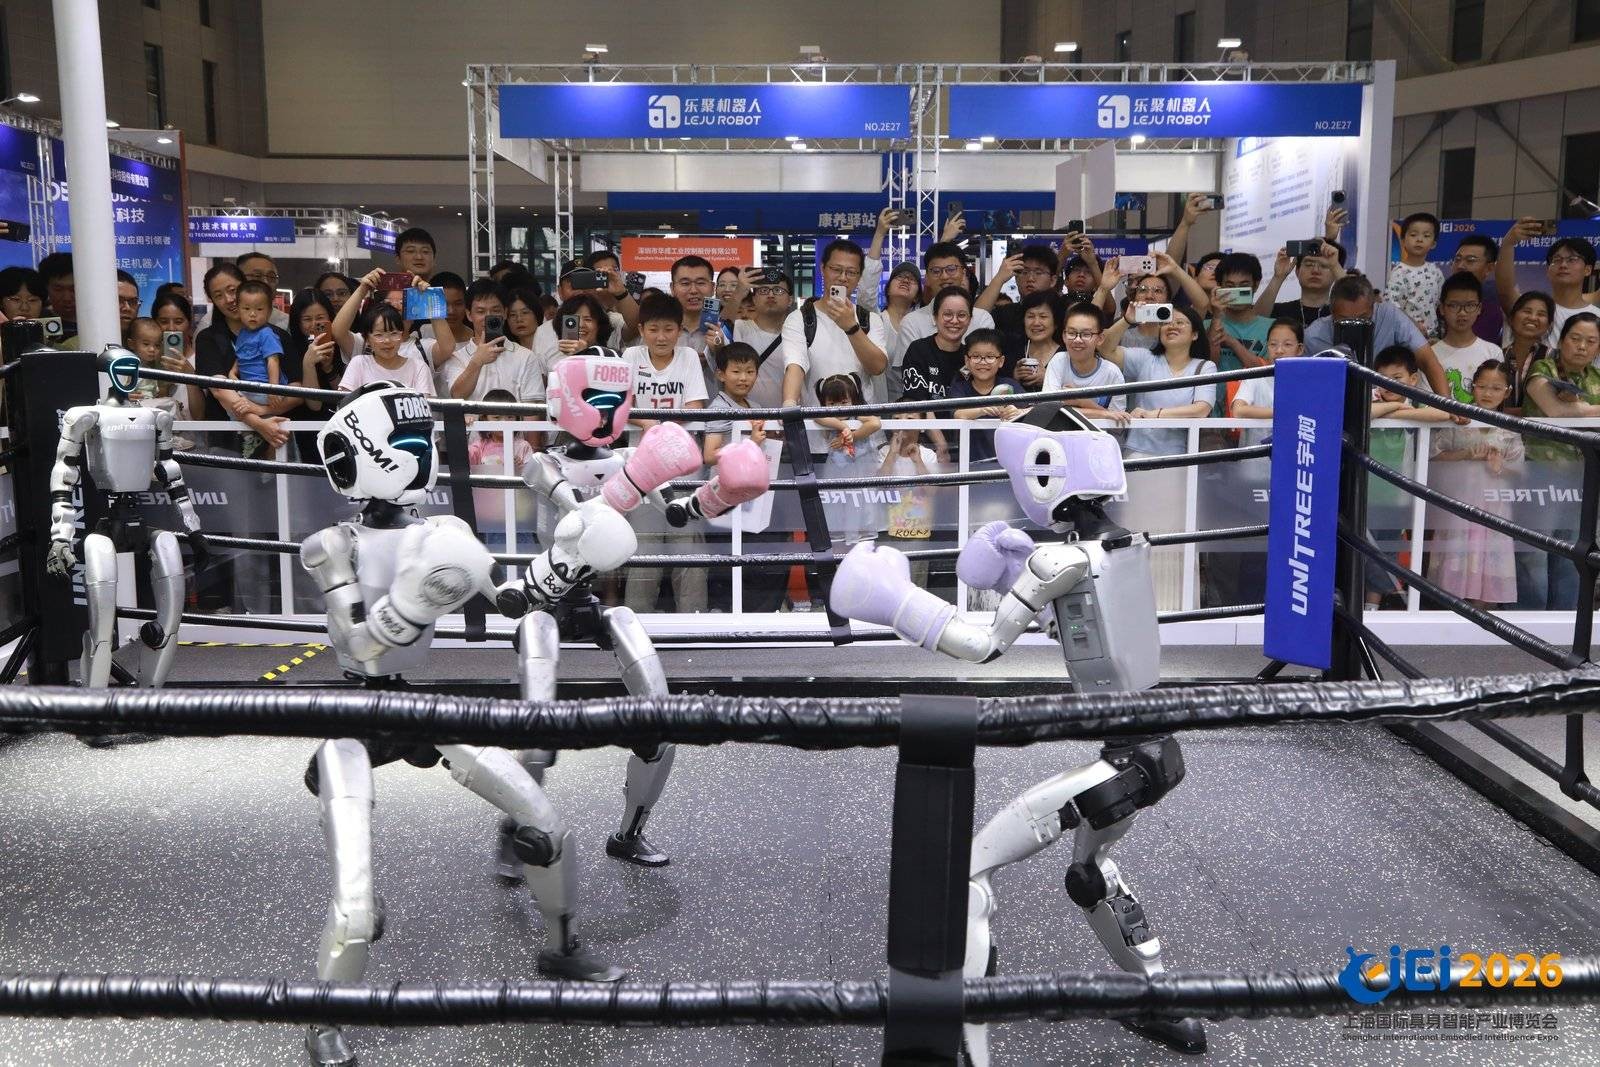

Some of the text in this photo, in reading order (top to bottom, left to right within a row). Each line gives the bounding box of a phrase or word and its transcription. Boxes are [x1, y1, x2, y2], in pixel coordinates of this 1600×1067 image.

[684, 98, 762, 113] 乐聚机器人
[1133, 97, 1211, 112] 乐聚机器人
[684, 115, 762, 125] LEJU ROBOT
[864, 122, 901, 131] NO.2E27
[1133, 115, 1211, 125] LEJU ROBOT
[1315, 120, 1352, 130] NO.2E27
[112, 207, 145, 223] 科技
[818, 212, 876, 228] 康养驿站
[593, 364, 630, 384] FORCE
[1288, 468, 1315, 616] UNITREE
